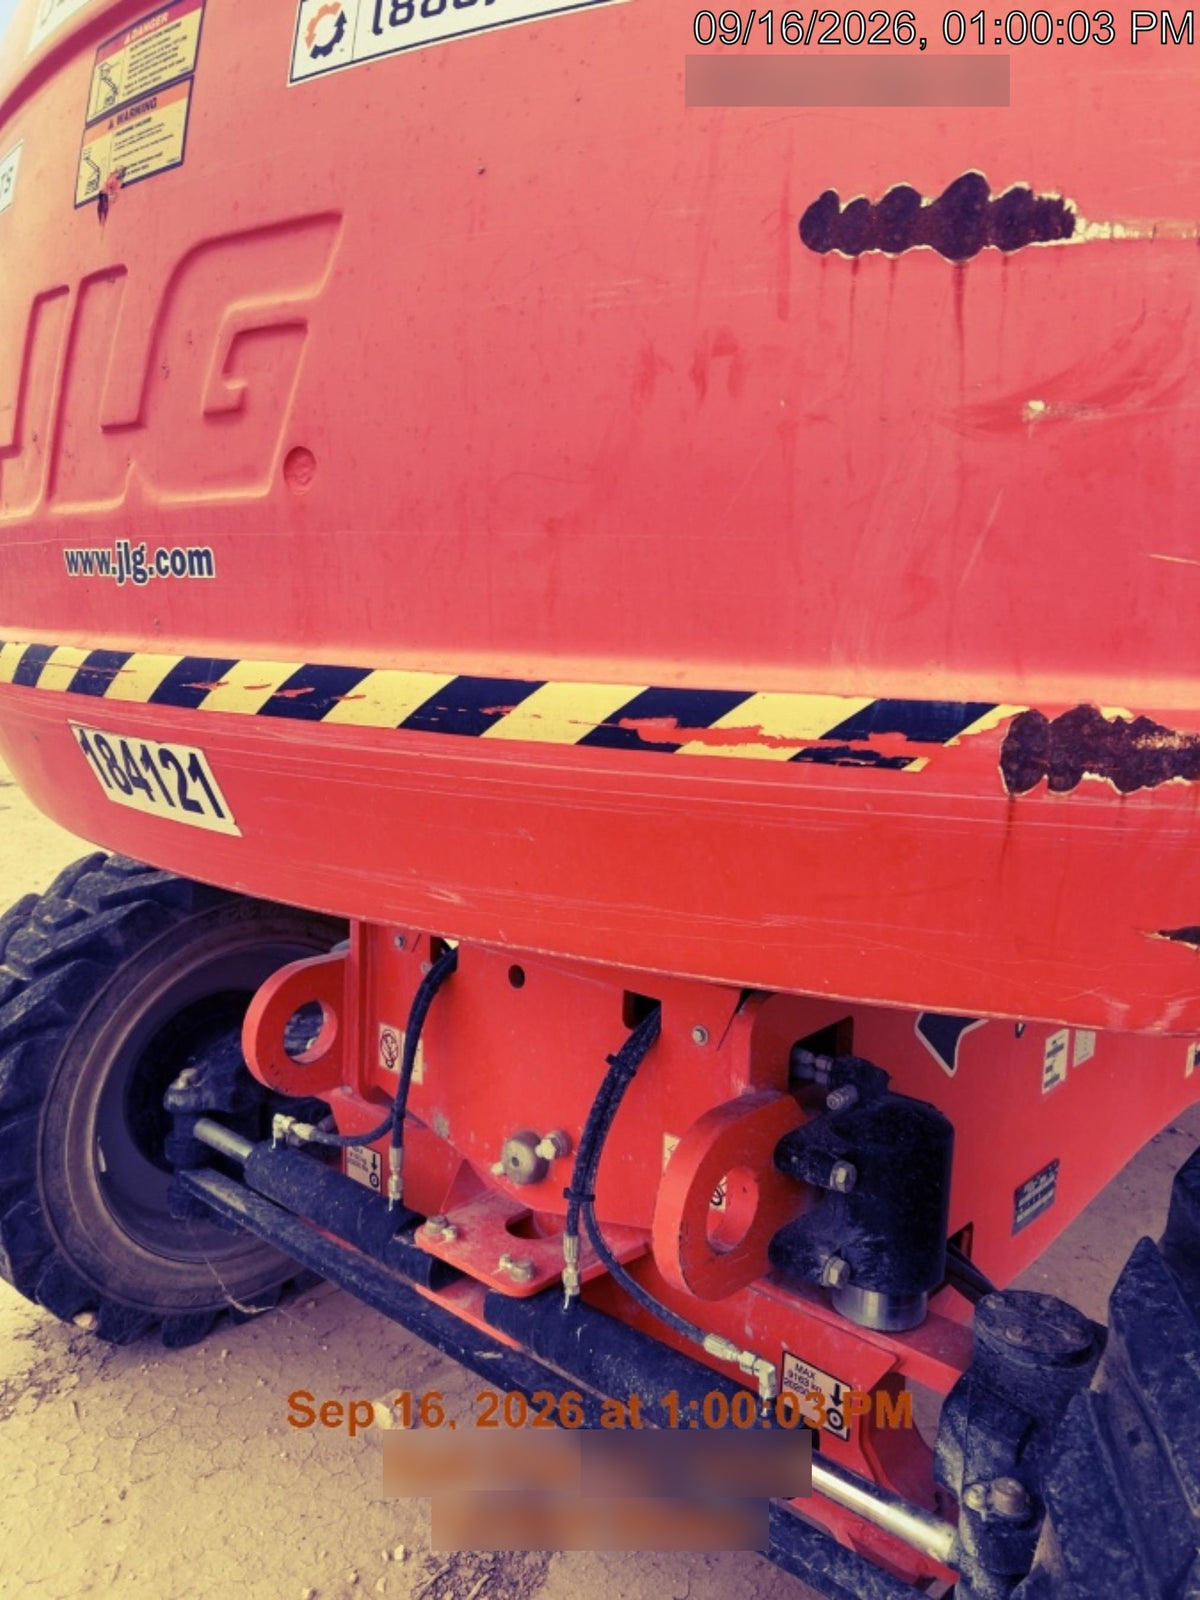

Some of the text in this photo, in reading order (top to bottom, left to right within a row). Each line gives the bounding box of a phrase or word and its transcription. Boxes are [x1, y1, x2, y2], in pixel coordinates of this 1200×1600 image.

[116, 96, 158, 126] WARNING
[64, 541, 214, 584] www.jlg.com
[79, 728, 226, 820] 184121
[795, 1363, 817, 1380] MAX
